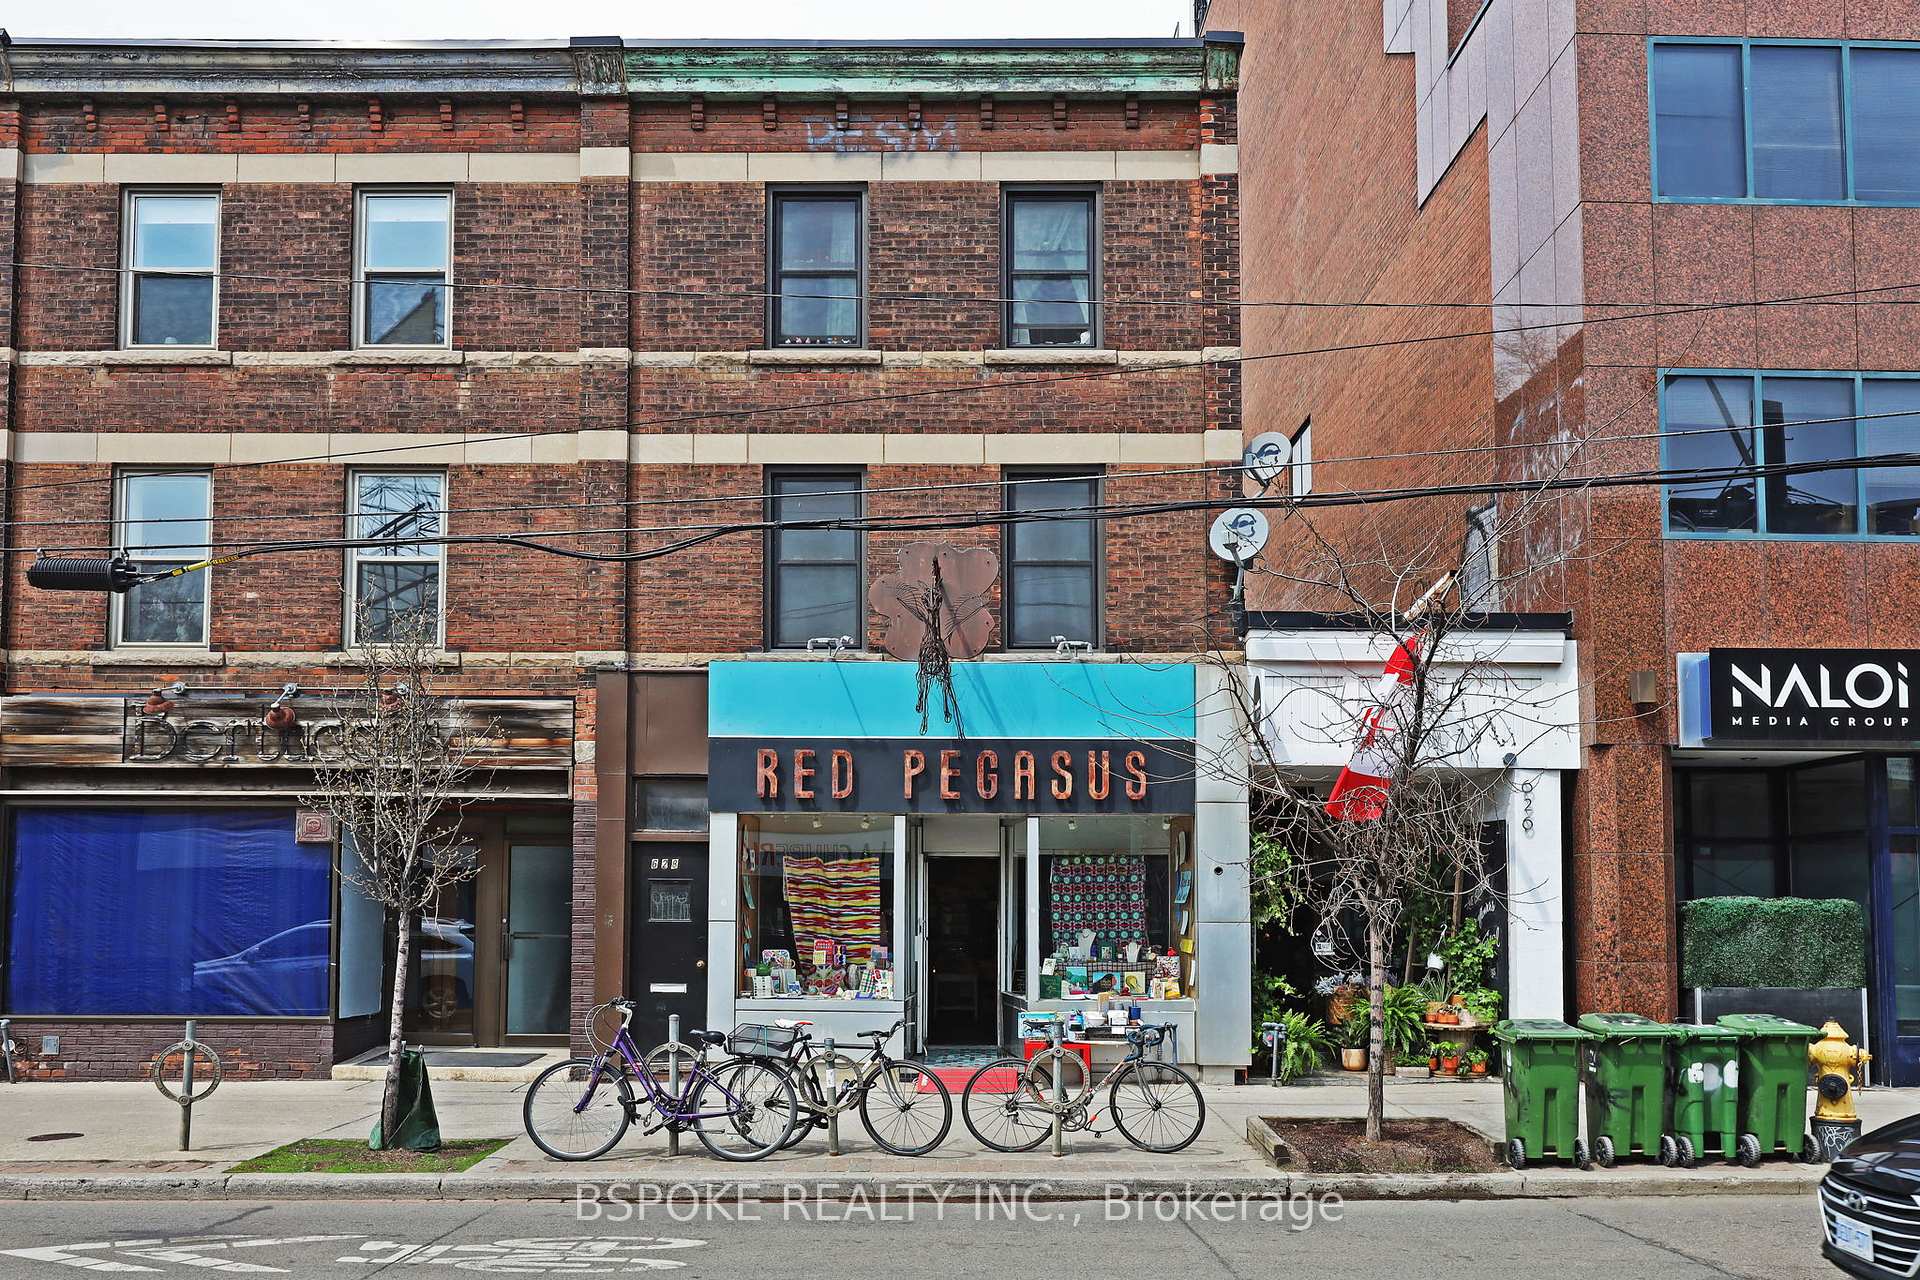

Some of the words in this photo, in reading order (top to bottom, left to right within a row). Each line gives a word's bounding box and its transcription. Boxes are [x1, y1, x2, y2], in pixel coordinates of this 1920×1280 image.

[1731, 716, 1809, 727] MEDIA
[1829, 716, 1910, 727] GROUP
[755, 748, 855, 800] RED
[903, 748, 1148, 800] PEGASUS
